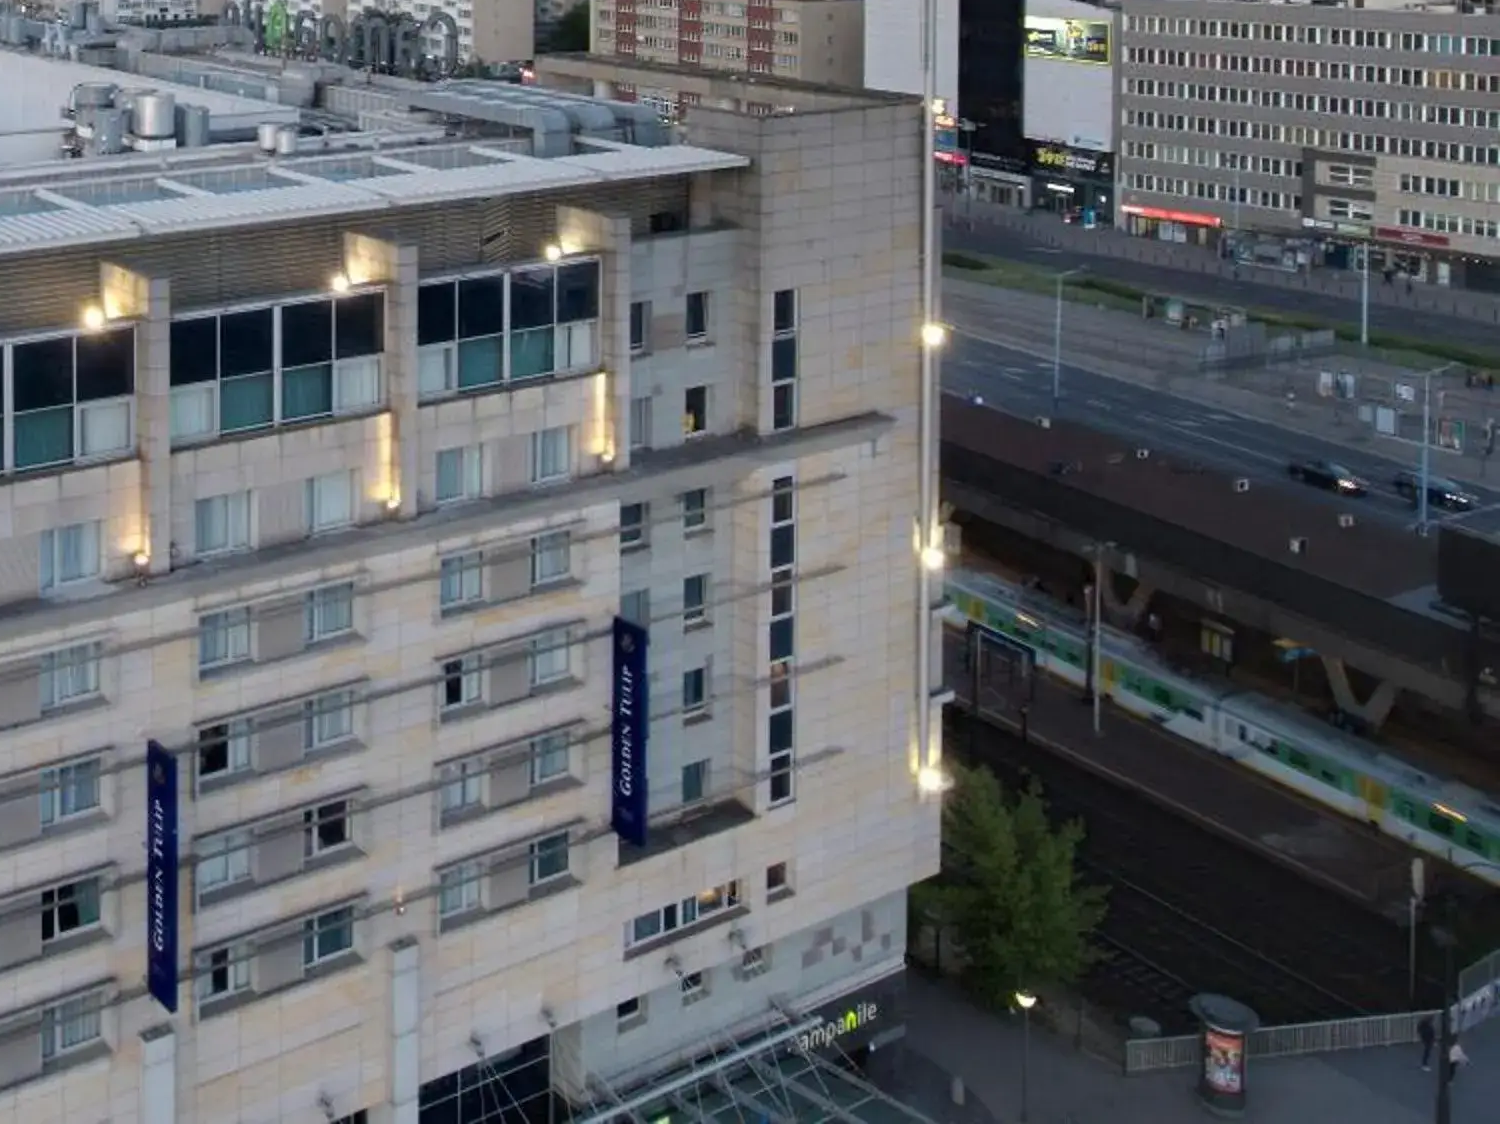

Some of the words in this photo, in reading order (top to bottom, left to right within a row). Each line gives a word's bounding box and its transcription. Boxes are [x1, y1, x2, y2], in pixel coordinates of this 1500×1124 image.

[619, 663, 634, 718] TULIP
[618, 722, 634, 797] GOLDEN
[152, 868, 165, 953] GOLDEN
[789, 1001, 878, 1052] ampanile
